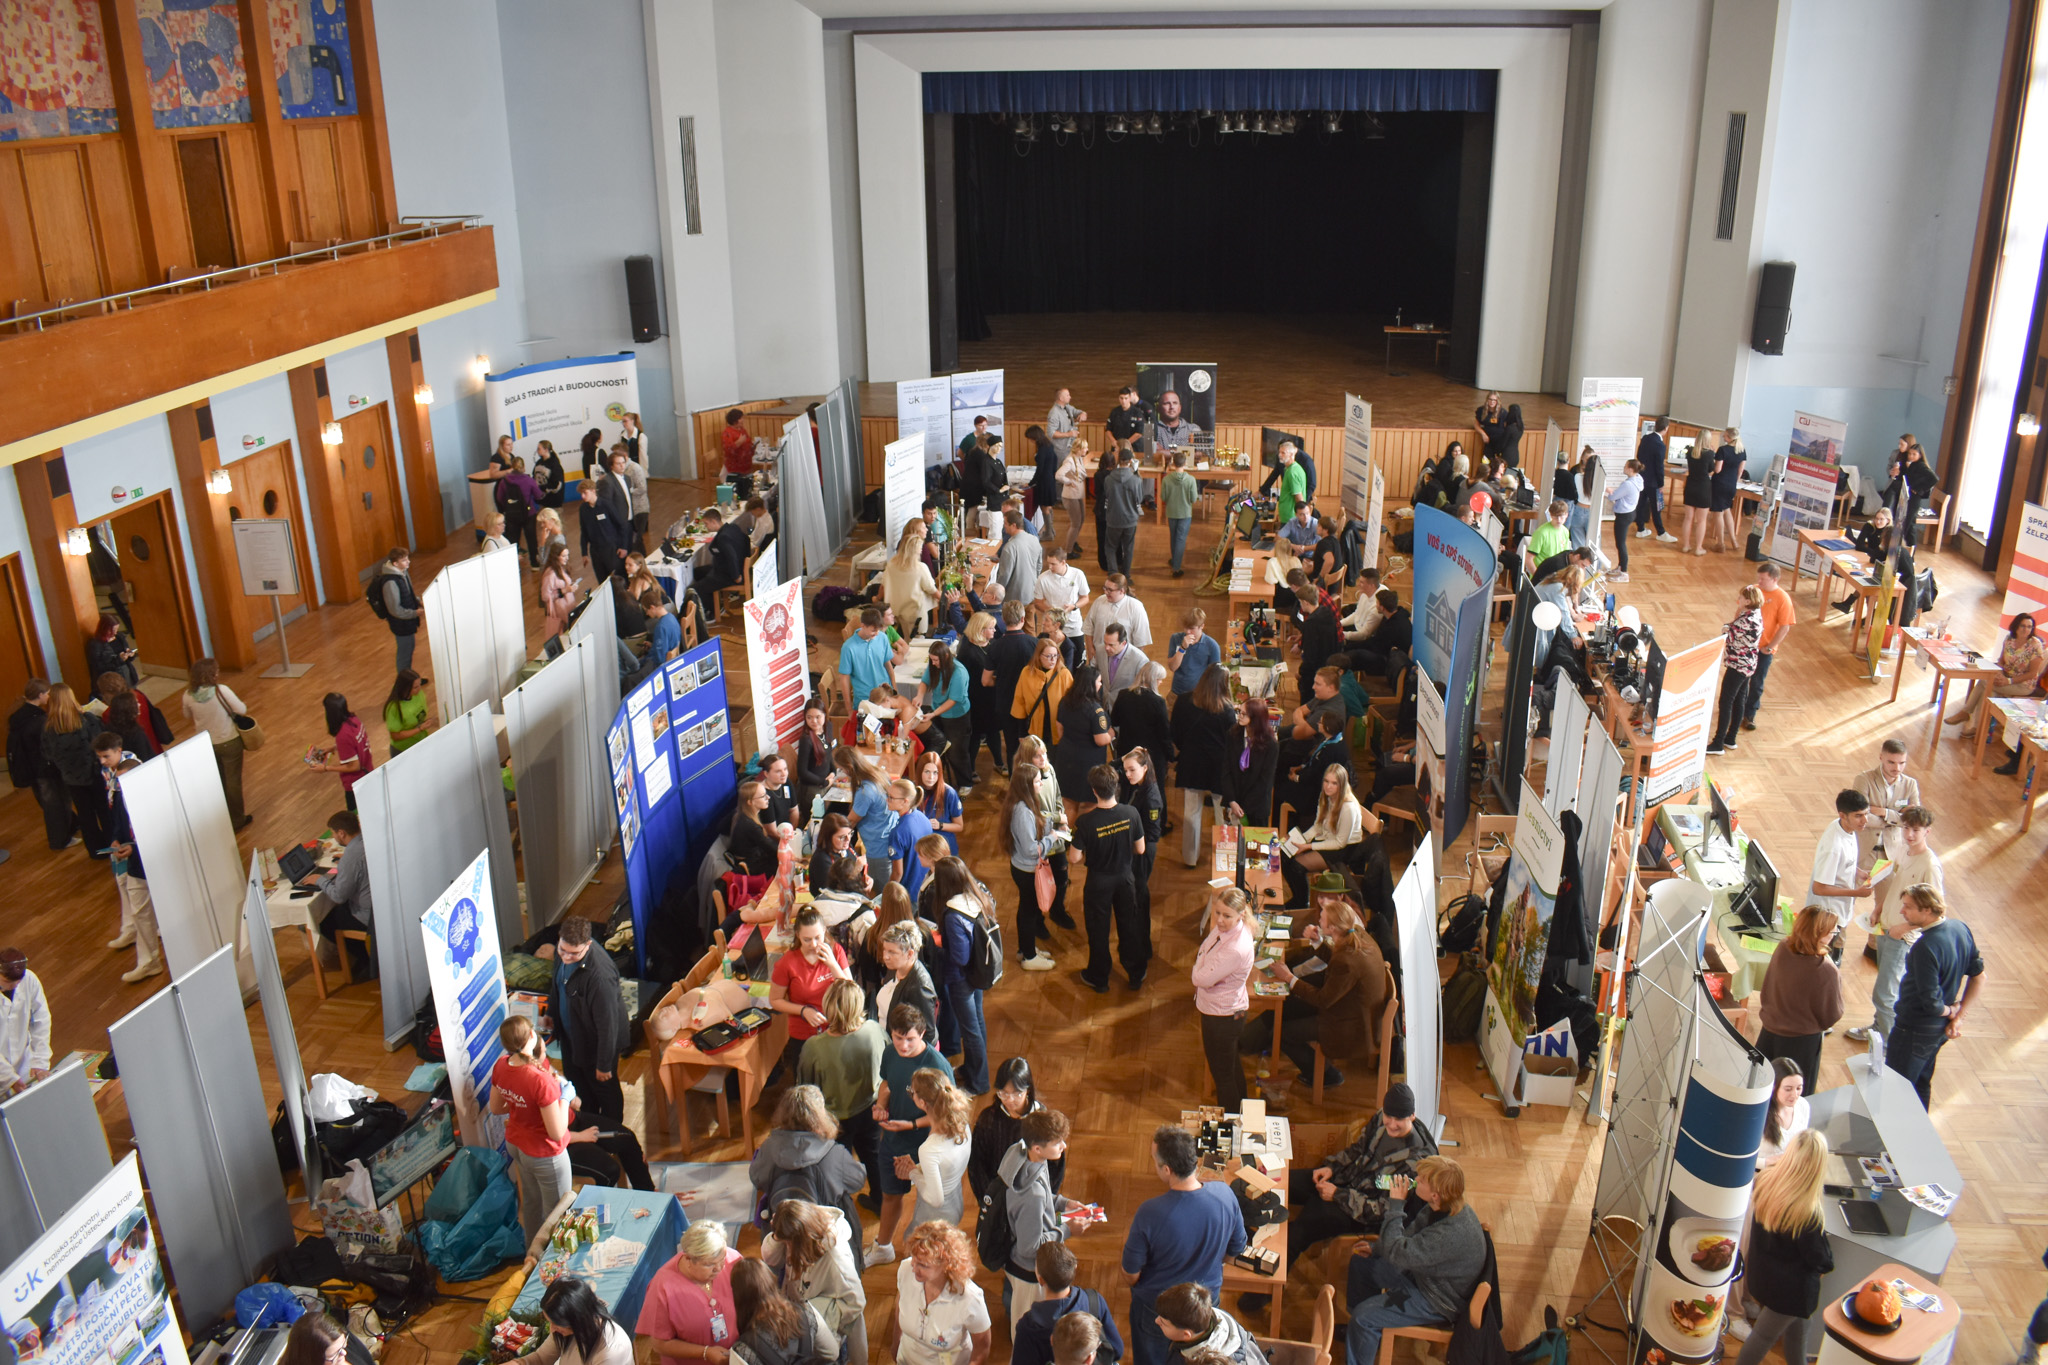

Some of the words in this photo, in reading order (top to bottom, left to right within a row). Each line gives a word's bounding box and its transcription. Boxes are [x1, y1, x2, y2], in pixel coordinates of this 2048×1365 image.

[504, 394, 521, 406] ŠKOLA
[522, 392, 527, 400] S
[527, 384, 557, 398] TRADICÍ
[566, 377, 628, 391] BUDOUCNOSTÍ
[1271, 1121, 1283, 1148] every
[43, 1240, 69, 1268] Krajská
[69, 1209, 101, 1243] zdravotní
[46, 1238, 83, 1276] nemocnice
[82, 1206, 117, 1240] Ústeckého
[116, 1190, 133, 1209] kraje
[84, 1259, 153, 1330] POSKYTOVATEL
[103, 1292, 149, 1344] REPUBLICE
[120, 1283, 143, 1309] PÉČE
